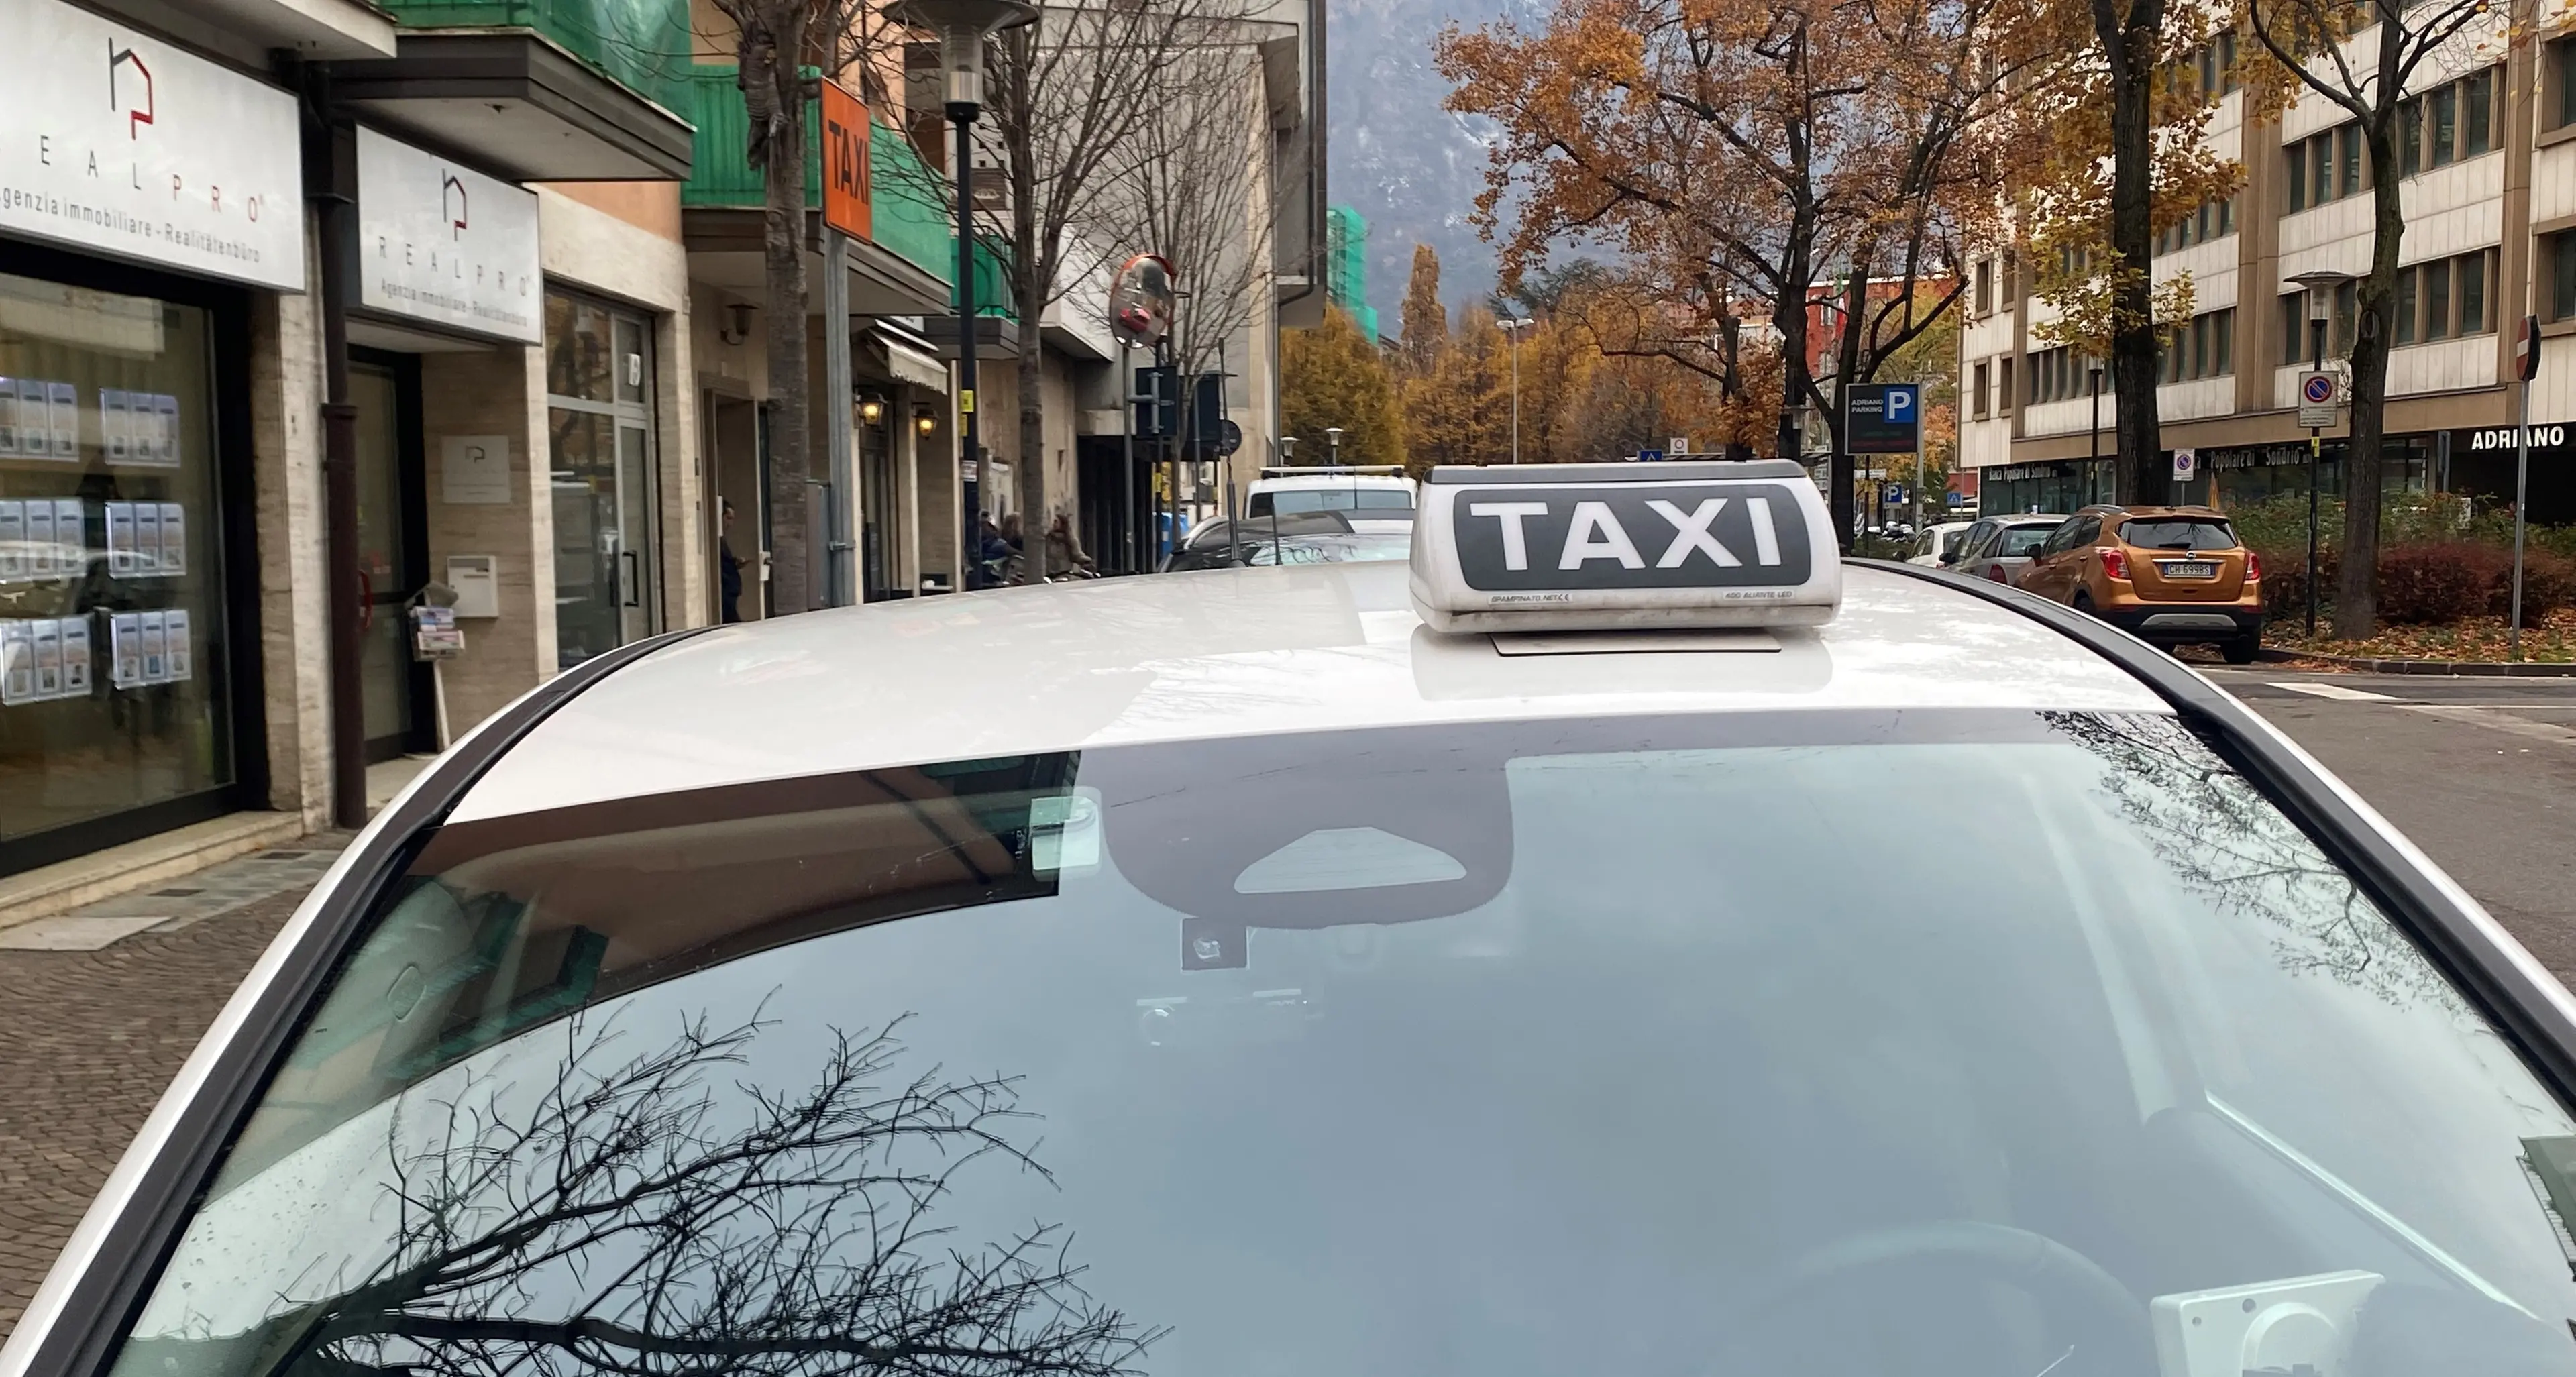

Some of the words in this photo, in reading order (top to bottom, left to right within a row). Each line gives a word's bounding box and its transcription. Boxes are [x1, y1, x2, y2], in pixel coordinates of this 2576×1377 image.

[0, 134, 258, 223] EALPRO
[828, 119, 869, 206] TAXI
[0, 186, 58, 215] genzia
[64, 195, 152, 238] immobiliare
[1888, 391, 1911, 419] P
[2266, 445, 2300, 466] Sondrio
[1888, 486, 1899, 501] P
[1469, 497, 1782, 571] TAXI
